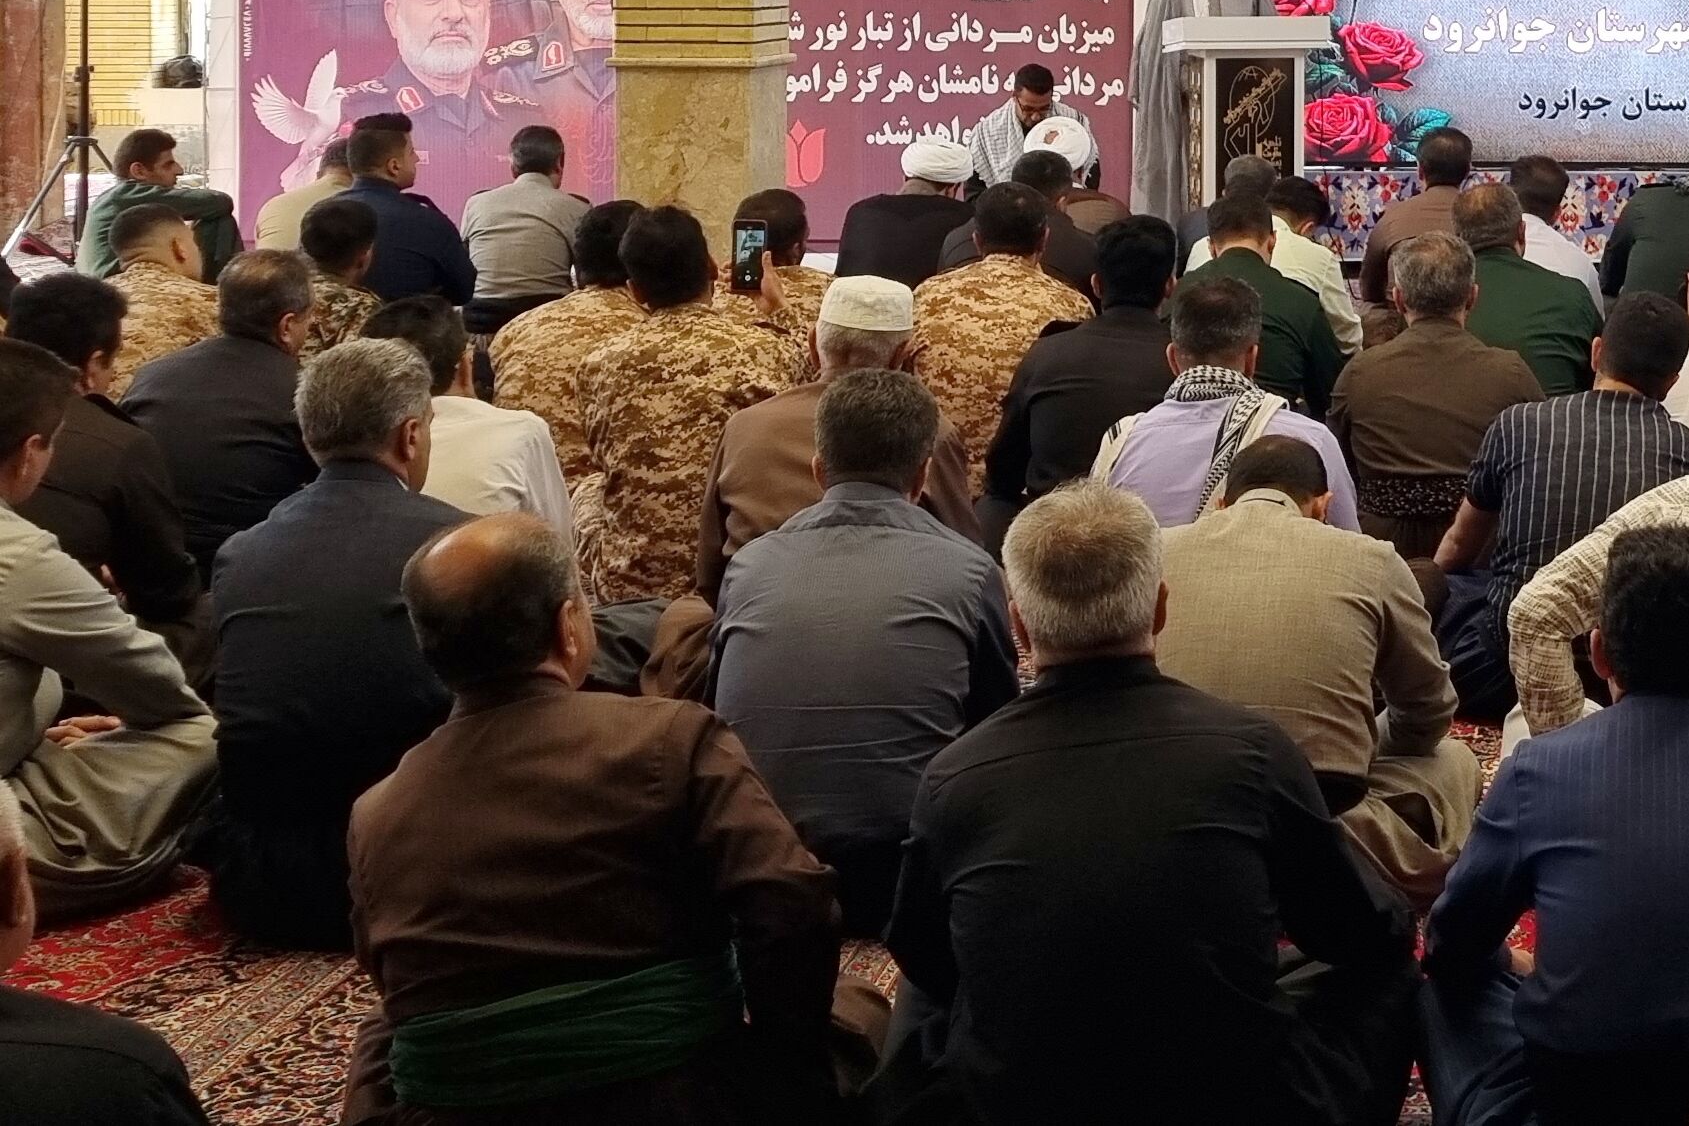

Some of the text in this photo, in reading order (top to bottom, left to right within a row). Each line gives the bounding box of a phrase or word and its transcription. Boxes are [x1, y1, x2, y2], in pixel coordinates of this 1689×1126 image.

[808, 11, 848, 52] نور
[851, 11, 894, 52] تبار
[897, 11, 921, 52] از
[924, 11, 1033, 53] مردانی
[1037, 12, 1115, 54] میزبان
[1422, 6, 1556, 55] جوانرود
[786, 60, 848, 103] فرامو
[851, 63, 914, 103] هرگز
[917, 63, 999, 103] نامشان
[1518, 88, 1612, 121] جوانرود
